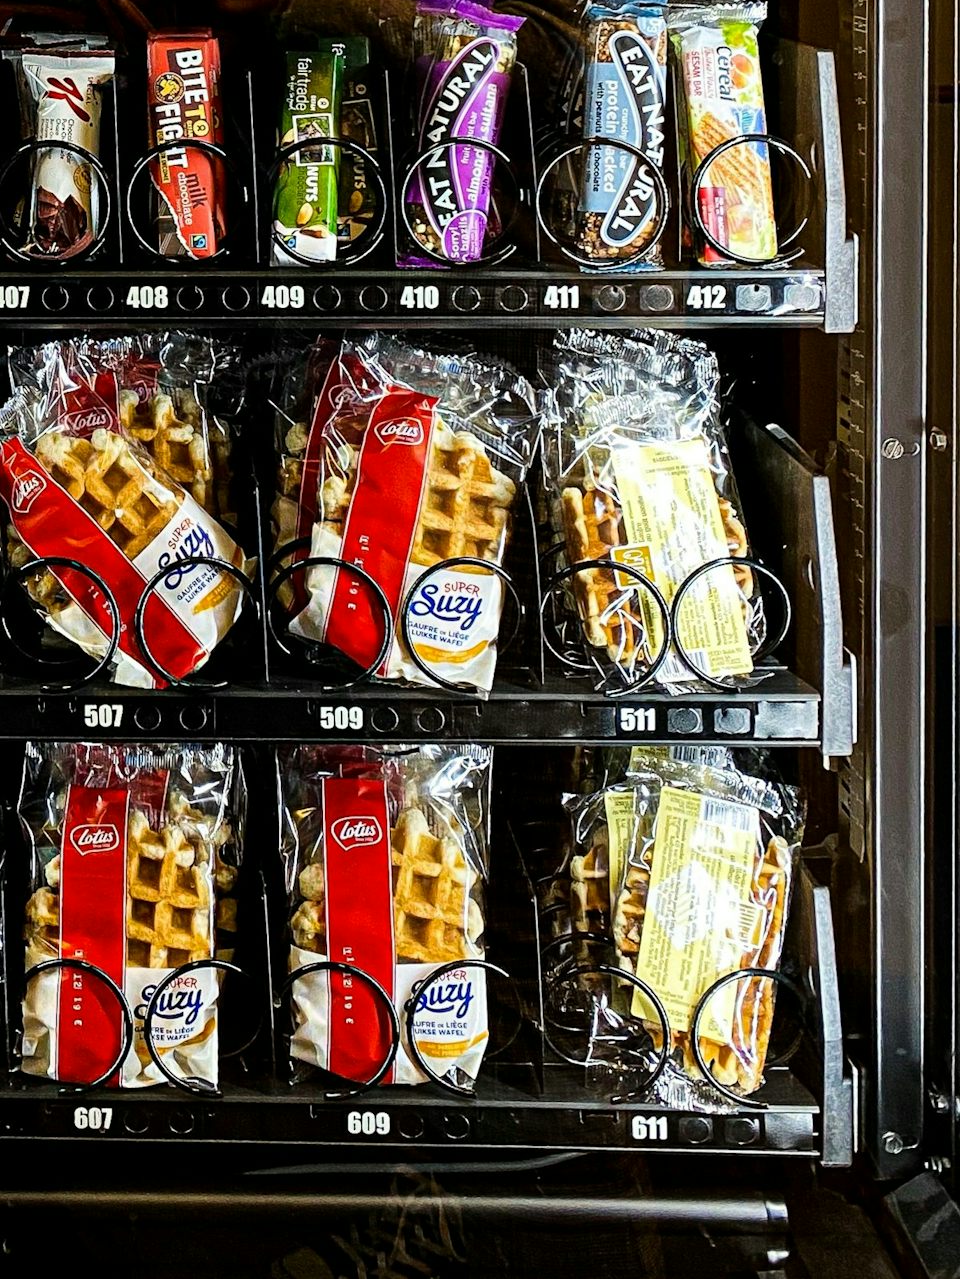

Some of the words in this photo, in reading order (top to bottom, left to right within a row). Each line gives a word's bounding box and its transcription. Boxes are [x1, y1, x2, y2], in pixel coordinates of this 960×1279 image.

[175, 49, 209, 104] BITE
[619, 44, 654, 95] EAT
[691, 50, 702, 78] SESAM
[716, 45, 737, 103] Cereal
[693, 80, 703, 97] BAR
[425, 48, 492, 170] NATURAL
[479, 82, 498, 134] sultana
[594, 99, 604, 133] peanuts
[604, 80, 619, 137] protein
[306, 165, 319, 202] NUTS
[465, 147, 485, 203] almond
[592, 153, 602, 193] chocolate
[611, 102, 666, 233] NATURAL
[177, 171, 193, 226] chocolate
[186, 173, 208, 209] milk
[429, 176, 461, 228] EAT
[126, 285, 169, 309] 408
[261, 285, 305, 309] 409
[400, 285, 440, 309] 410
[544, 285, 580, 309] 411
[686, 284, 727, 309] 412
[168, 517, 195, 551] SUPER
[157, 522, 215, 591] Suzy
[443, 581, 481, 595] SUPER
[410, 583, 483, 631] Suzy
[448, 628, 470, 642] LIÈGE
[84, 704, 124, 728] 507
[319, 705, 365, 730] 509
[621, 707, 656, 731] 511
[339, 820, 377, 839] Lotus
[135, 984, 203, 1024] Suzy
[404, 978, 475, 1018] Suzy
[438, 1027, 465, 1037] WAFEL
[446, 1019, 468, 1029] LIÈGE
[73, 1106, 113, 1130] 607
[347, 1111, 391, 1135] 609
[631, 1115, 668, 1140] 611
